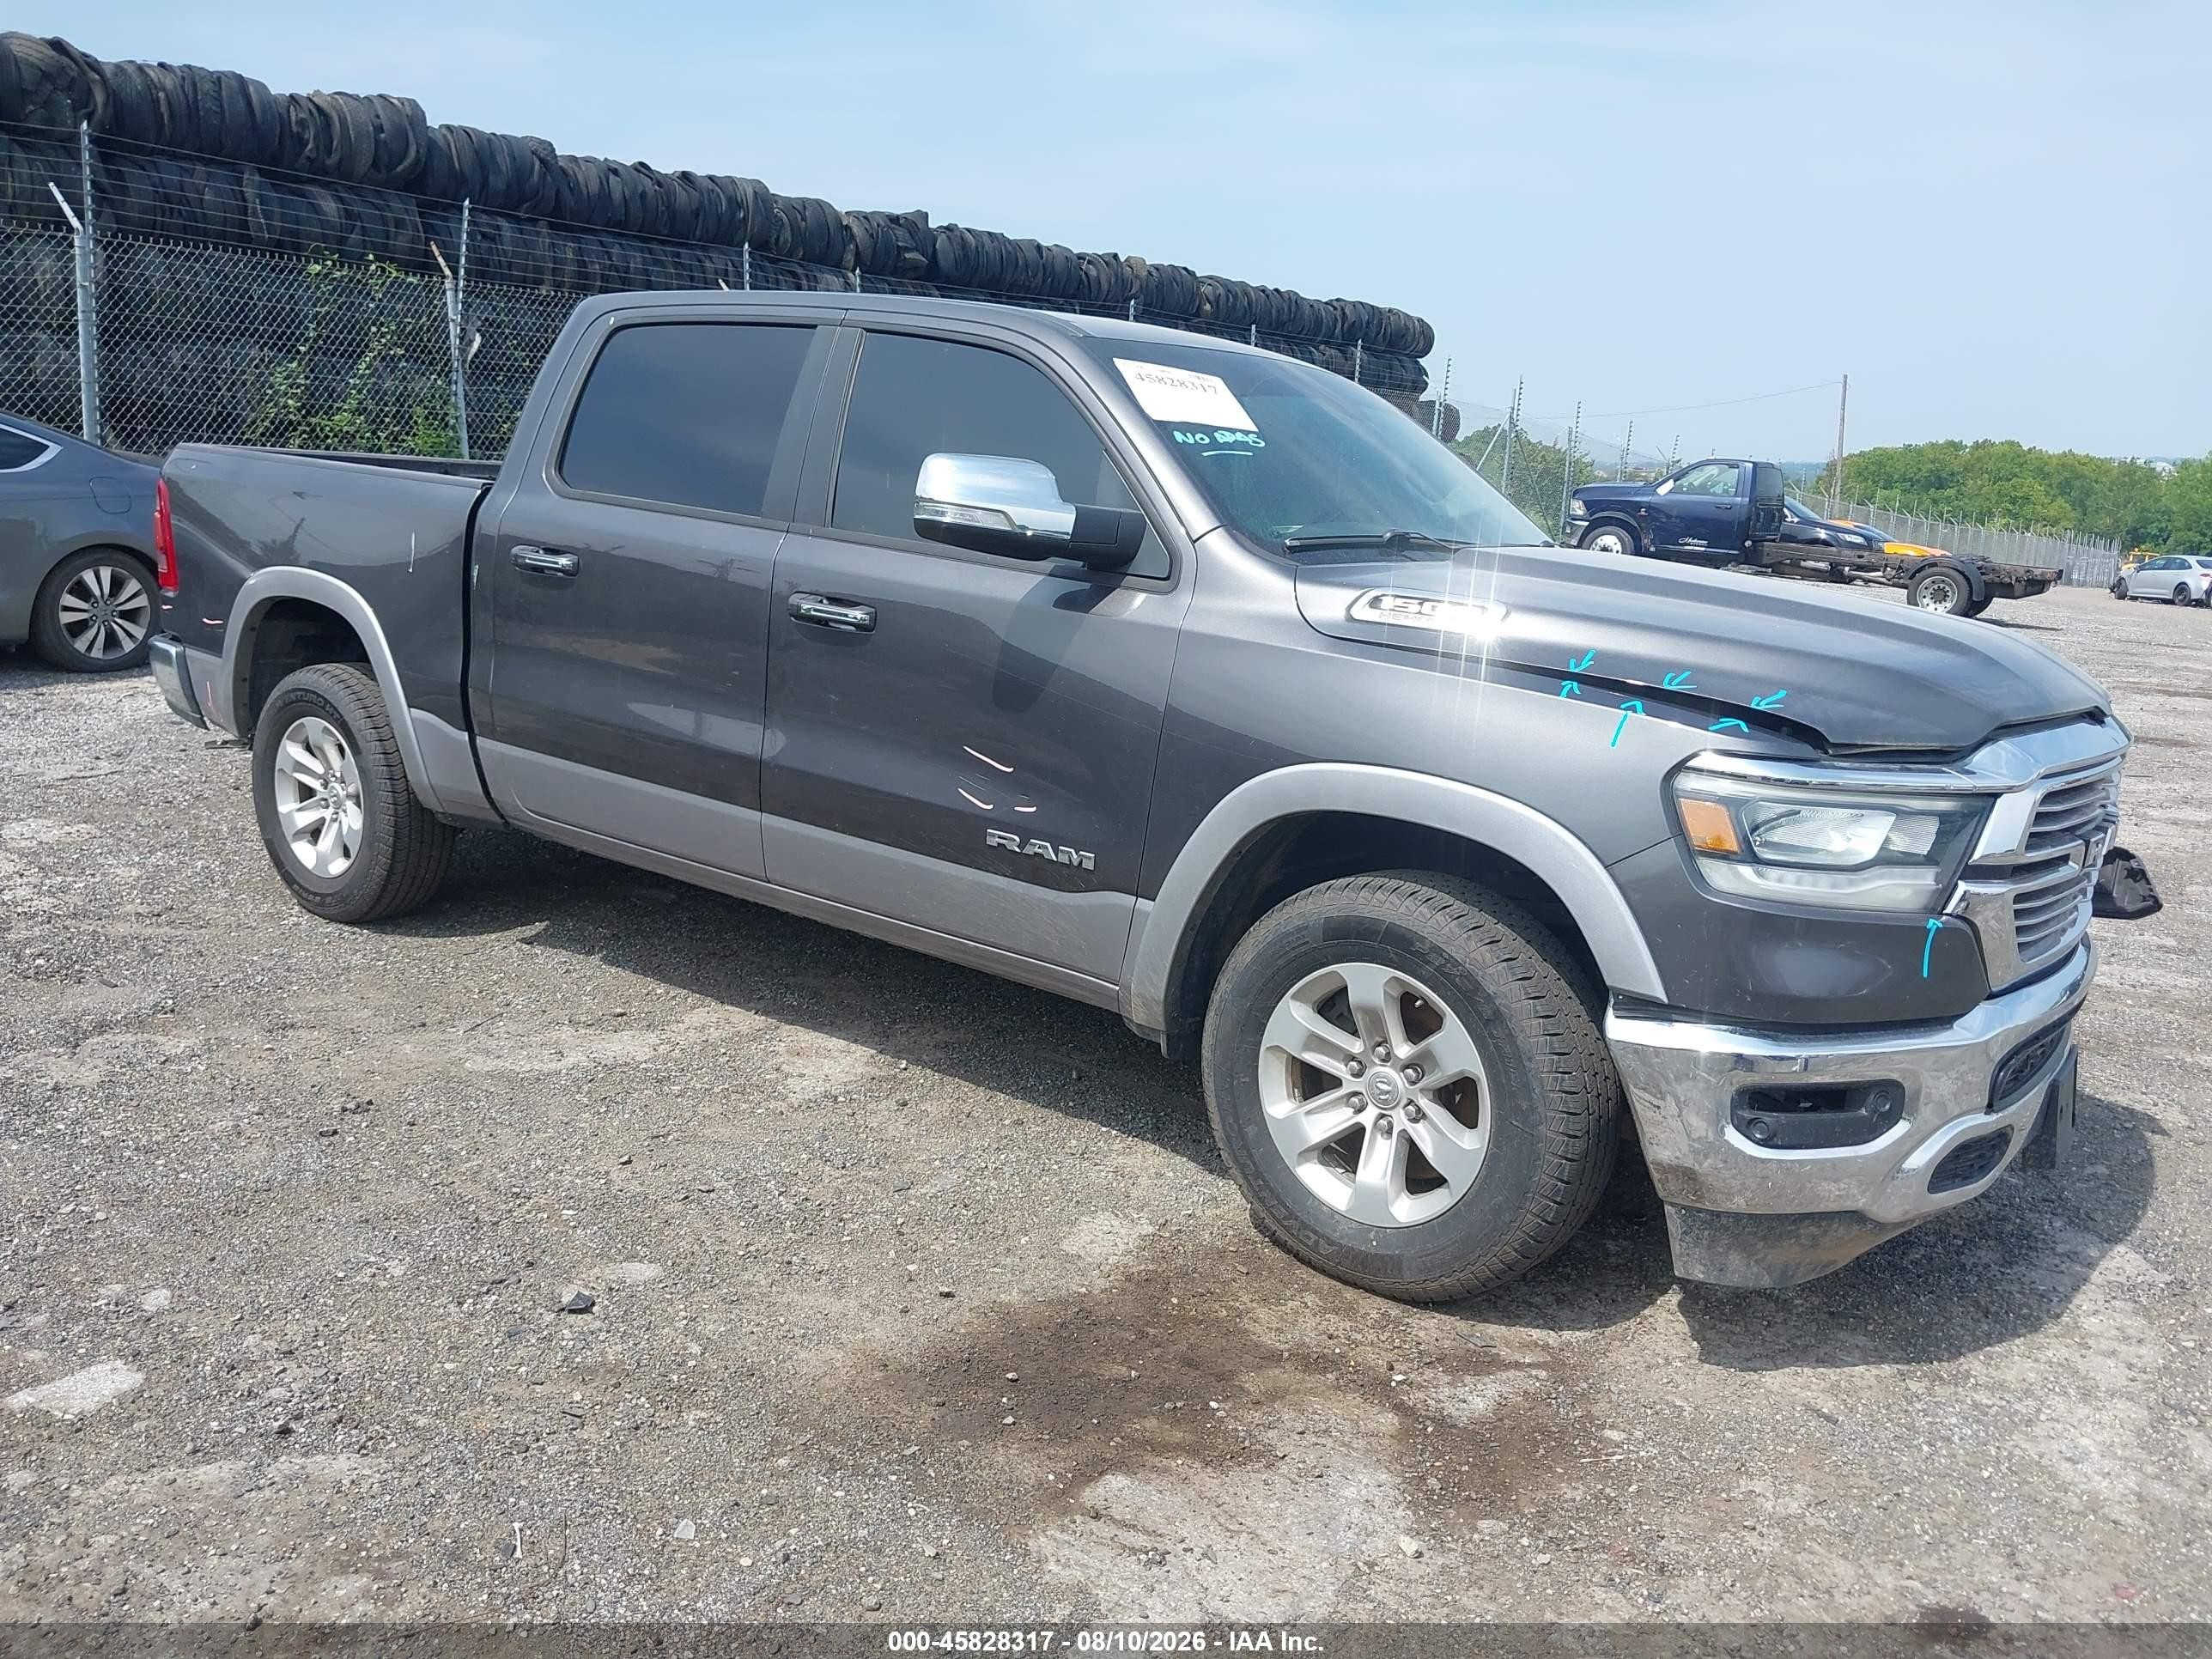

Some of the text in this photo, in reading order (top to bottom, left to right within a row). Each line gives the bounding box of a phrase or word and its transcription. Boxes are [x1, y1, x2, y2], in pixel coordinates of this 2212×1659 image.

[1134, 371, 1218, 395] 45828317
[1173, 430, 1210, 445] NO
[986, 829, 1096, 871] RAM
